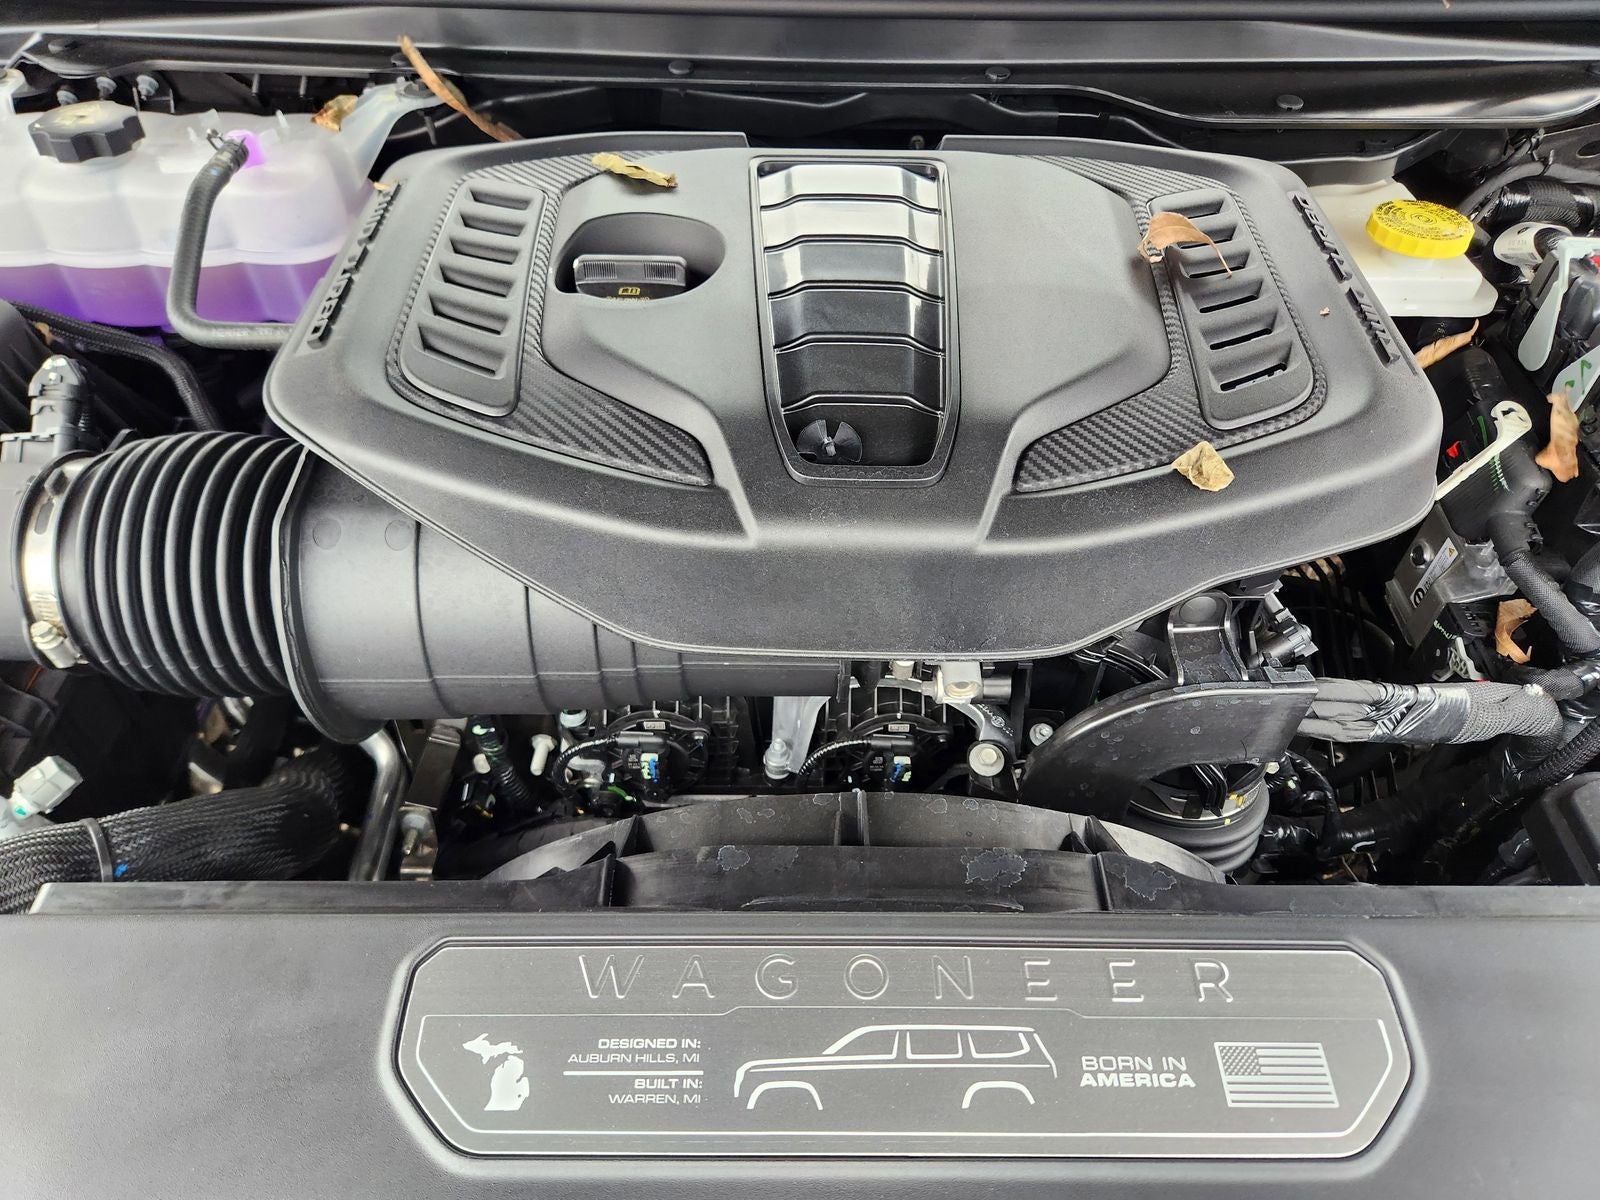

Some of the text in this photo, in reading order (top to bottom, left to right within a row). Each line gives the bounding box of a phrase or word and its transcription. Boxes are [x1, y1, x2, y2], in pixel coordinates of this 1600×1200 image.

[1291, 194, 1352, 283] TURBO
[306, 244, 370, 349] TURBO
[578, 953, 1234, 1003] WAGONEER
[598, 1038, 702, 1049] DESIGNED IN:
[567, 1053, 700, 1064] AUBURN HILLS, MI
[1081, 1055, 1187, 1072] BORN IN
[634, 1078, 703, 1089] BUILT IN:
[1079, 1072, 1196, 1088] AMERICA
[608, 1094, 701, 1105] WARREN, MI
